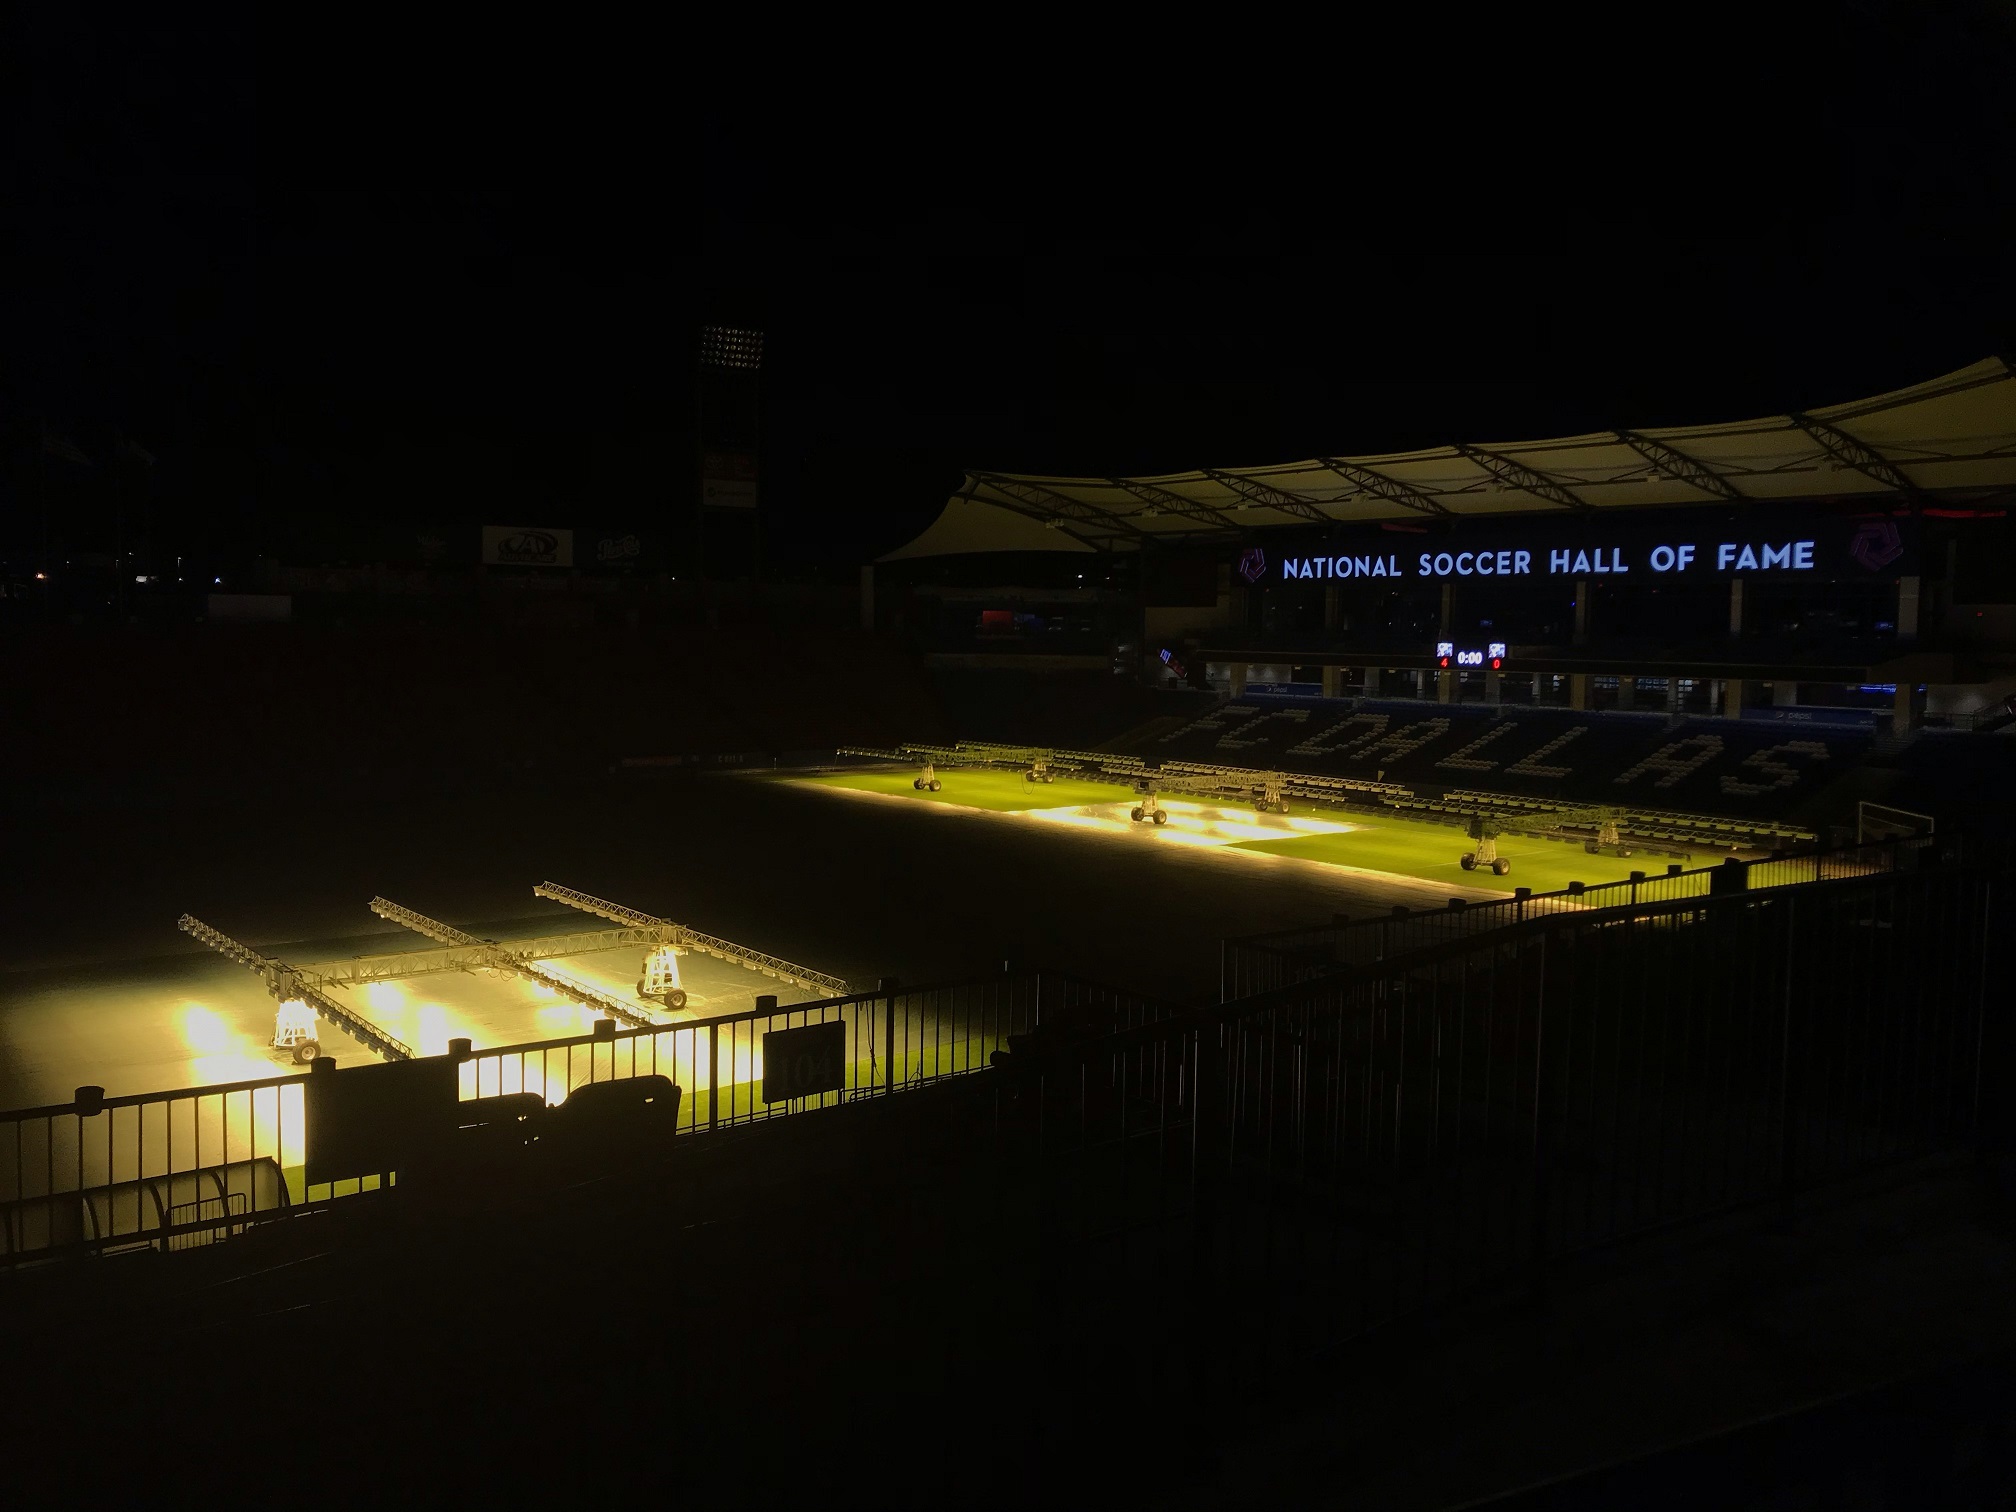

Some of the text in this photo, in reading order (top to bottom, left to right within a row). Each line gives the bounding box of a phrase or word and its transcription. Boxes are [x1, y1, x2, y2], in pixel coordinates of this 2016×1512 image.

[1283, 540, 1815, 580] NATIONAL SOCCER HALL OF FAME
[1440, 657, 1449, 668] 4
[1456, 650, 1484, 665] 0:00
[1787, 711, 1813, 721] pepsi
[1158, 705, 1831, 796] FC DALLAS
